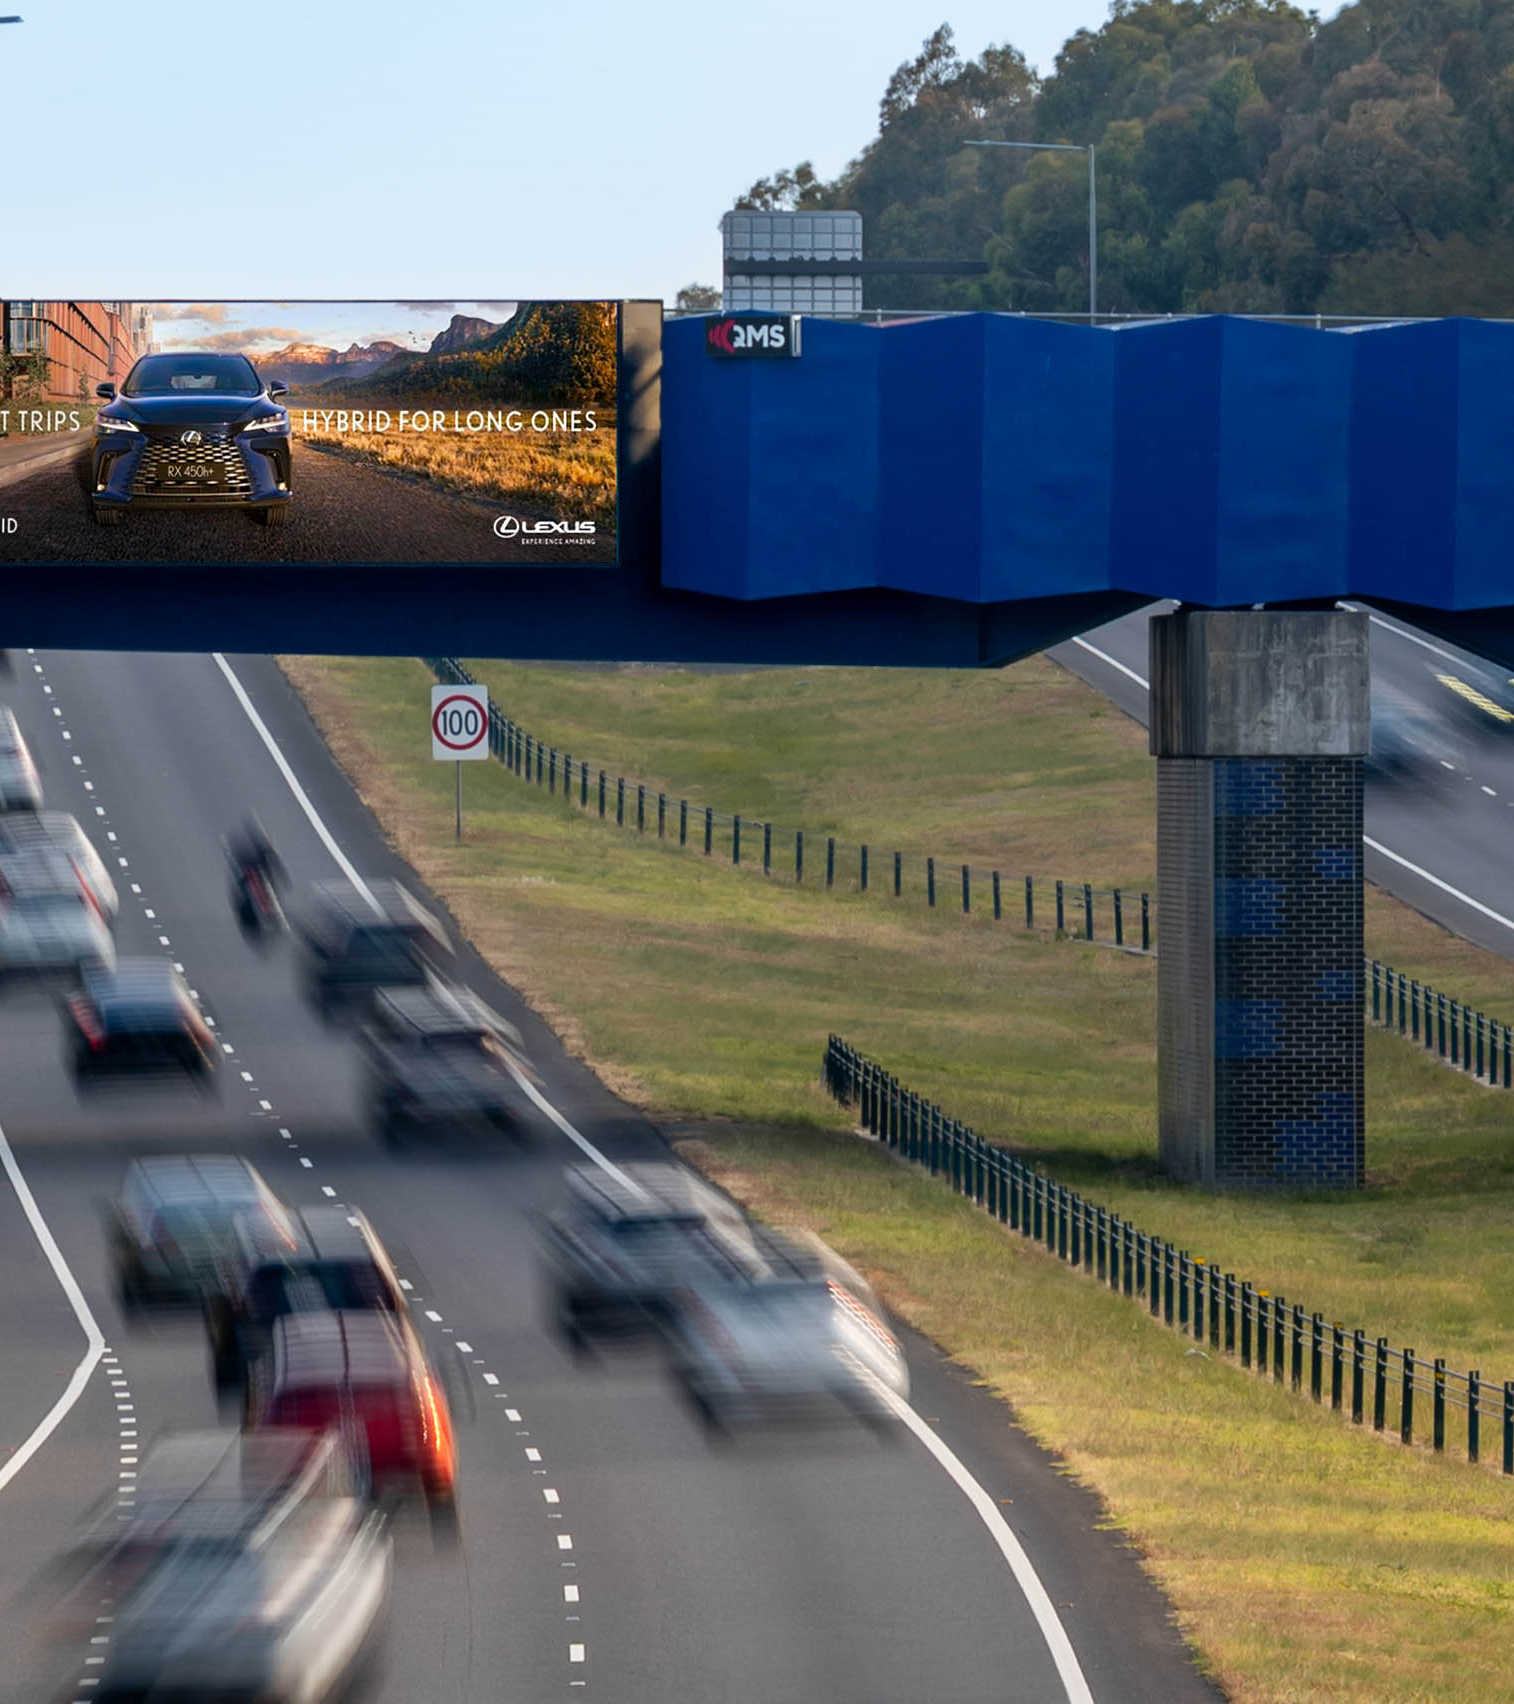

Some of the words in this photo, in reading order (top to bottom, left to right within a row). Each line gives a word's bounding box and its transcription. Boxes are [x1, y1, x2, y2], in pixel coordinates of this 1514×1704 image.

[18, 410, 80, 431] TRIPS
[302, 410, 391, 432] HYBRID
[399, 410, 446, 432] FOR
[454, 410, 523, 432] LONG
[531, 410, 597, 432] ONES
[168, 465, 182, 477] RX
[184, 465, 214, 477] 450h+
[521, 521, 596, 533] LEXUS
[442, 709, 478, 736] 100
